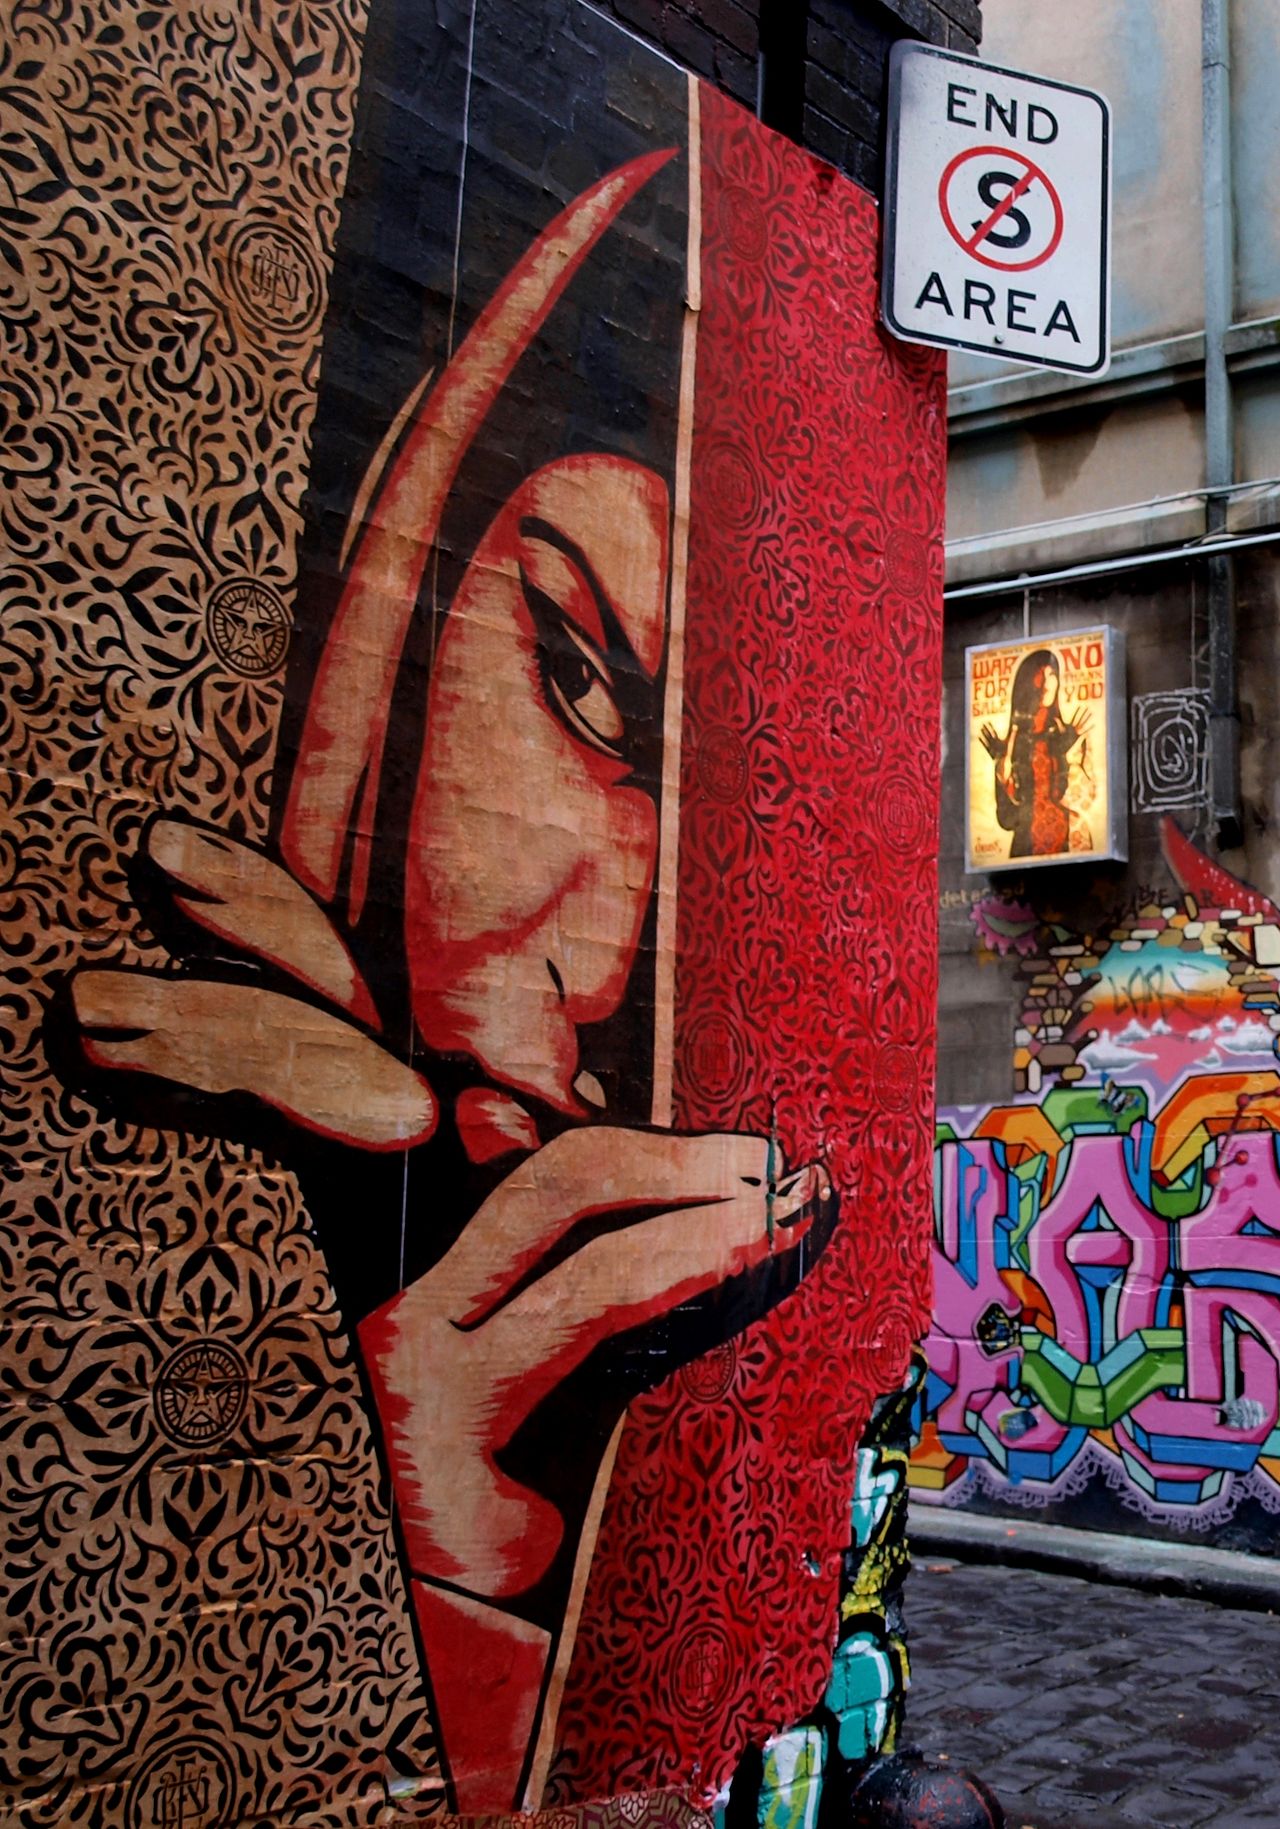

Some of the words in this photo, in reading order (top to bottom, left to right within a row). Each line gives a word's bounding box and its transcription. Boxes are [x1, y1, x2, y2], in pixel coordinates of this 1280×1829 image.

[947, 82, 1059, 145] END
[971, 171, 1032, 249] S
[914, 271, 1081, 344] AREA
[973, 656, 1018, 680] WAR
[1059, 642, 1103, 672] NO
[973, 677, 1009, 700] FOR
[1064, 682, 1104, 703] YOU
